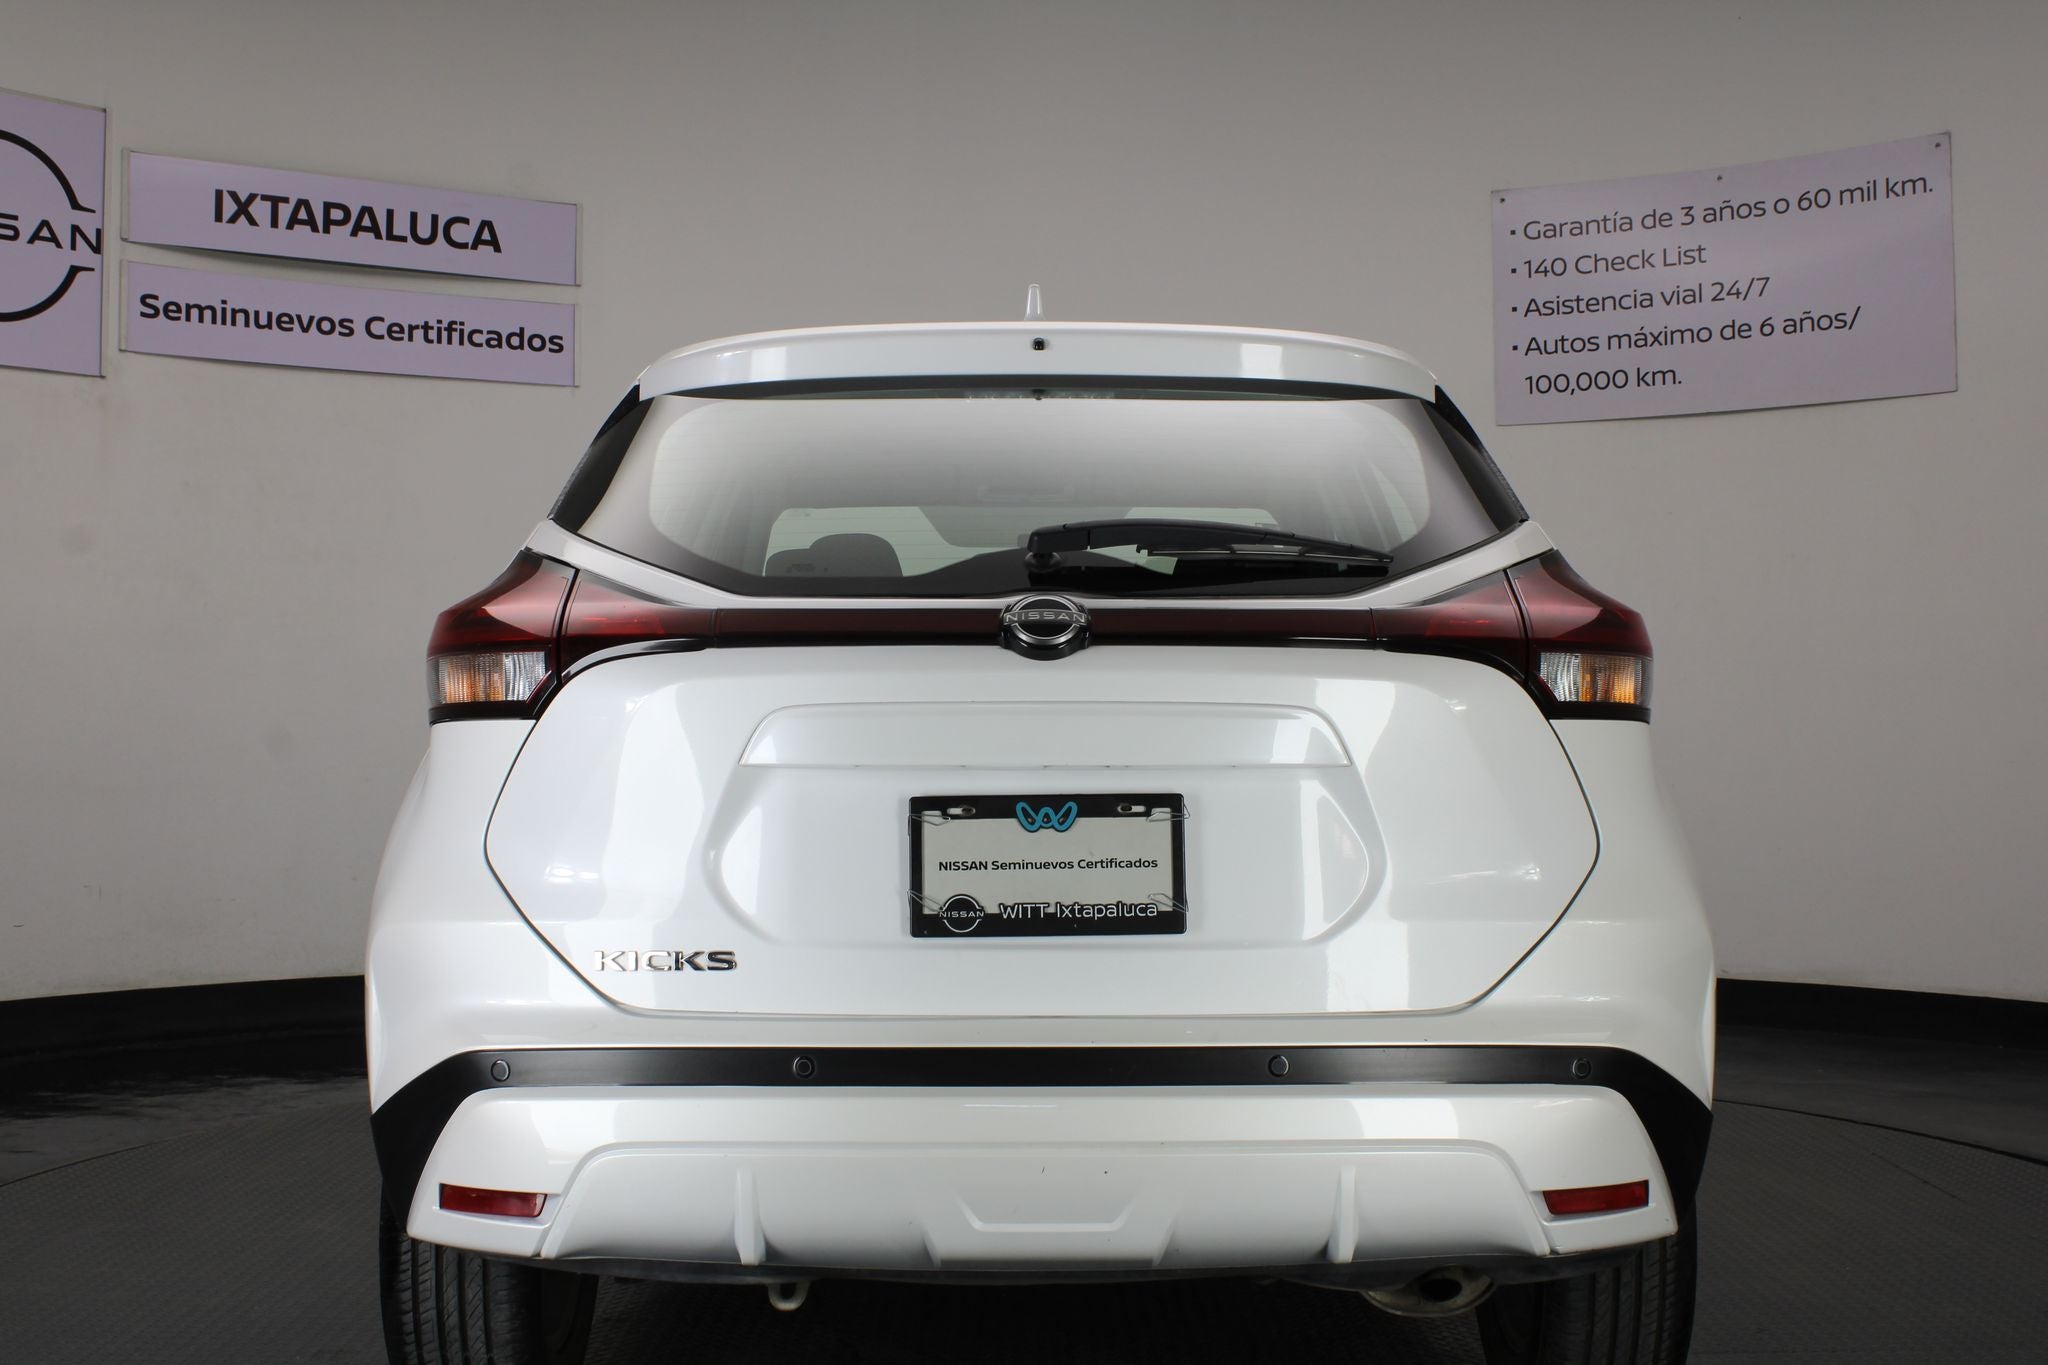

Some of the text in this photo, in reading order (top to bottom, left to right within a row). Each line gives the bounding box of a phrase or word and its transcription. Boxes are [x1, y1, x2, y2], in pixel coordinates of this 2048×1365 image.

[214, 189, 503, 254] IXTAPALUCA
[1523, 176, 1934, 241] Garantía de 3 años o 60 mil km.
[1523, 243, 1707, 279] 140 Check List
[1523, 276, 1771, 318] Asistencia vial 24/7
[139, 293, 565, 354] Seminuevos Certificados
[1524, 305, 1862, 357] Autos máximo de 6 años/
[1524, 366, 1683, 396] 100,000 km.
[1005, 611, 1085, 622] NISSAN
[938, 857, 1159, 872] NISSAN Seminuevos Certificados
[939, 909, 984, 918] NISSAN
[1000, 901, 1158, 920] WITT Ixtapaluca
[593, 950, 738, 971] KICKS
